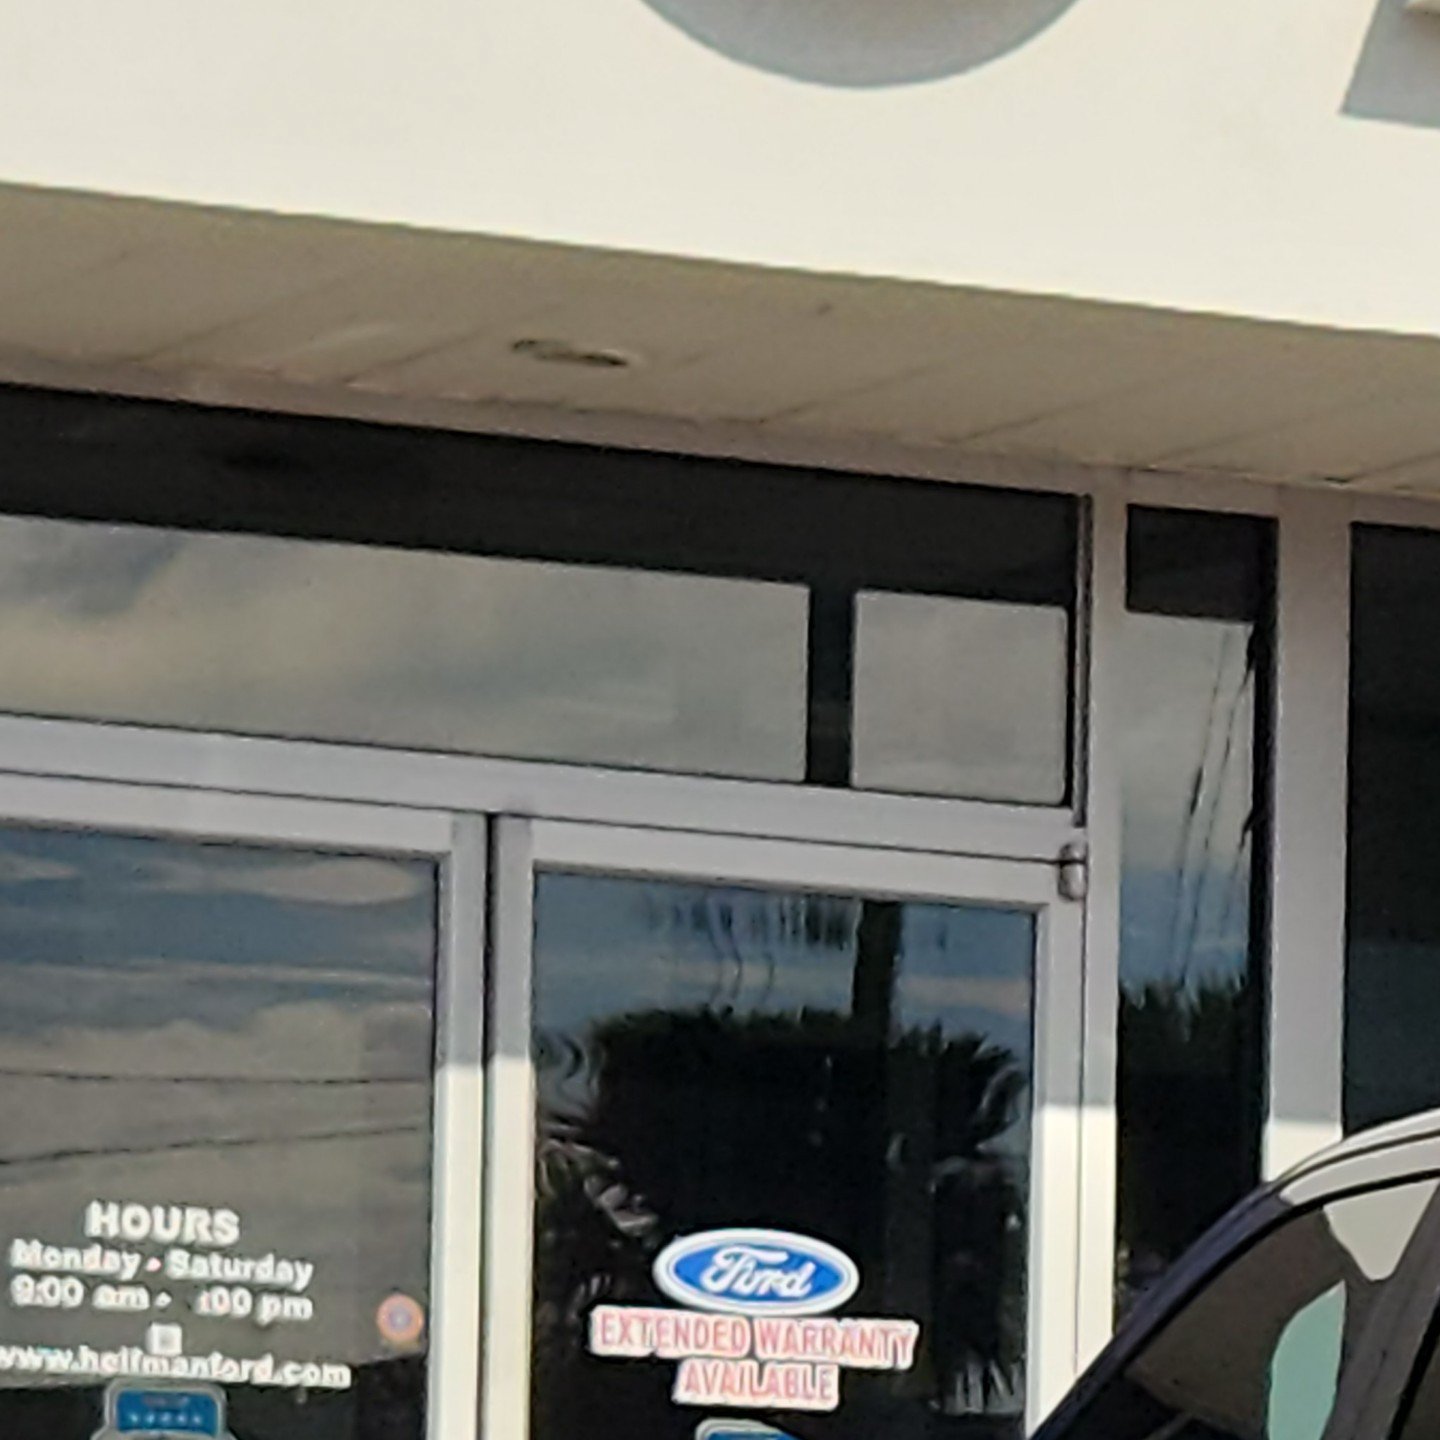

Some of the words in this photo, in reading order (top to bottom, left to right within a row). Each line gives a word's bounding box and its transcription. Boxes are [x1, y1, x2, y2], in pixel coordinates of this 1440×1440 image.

[85, 1200, 240, 1246] HOURS
[10, 1237, 141, 1281] Monday
[164, 1249, 314, 1292] Saturday
[700, 1245, 818, 1298] Ford
[10, 1274, 85, 1308] 9:00
[92, 1283, 150, 1311] am
[257, 1292, 313, 1327] pm
[600, 1310, 749, 1353] EXTENDED
[753, 1318, 913, 1363] WARRANTY
[0, 1344, 352, 1389] www.helfmanford.com
[683, 1361, 835, 1402] AVAILABLE
